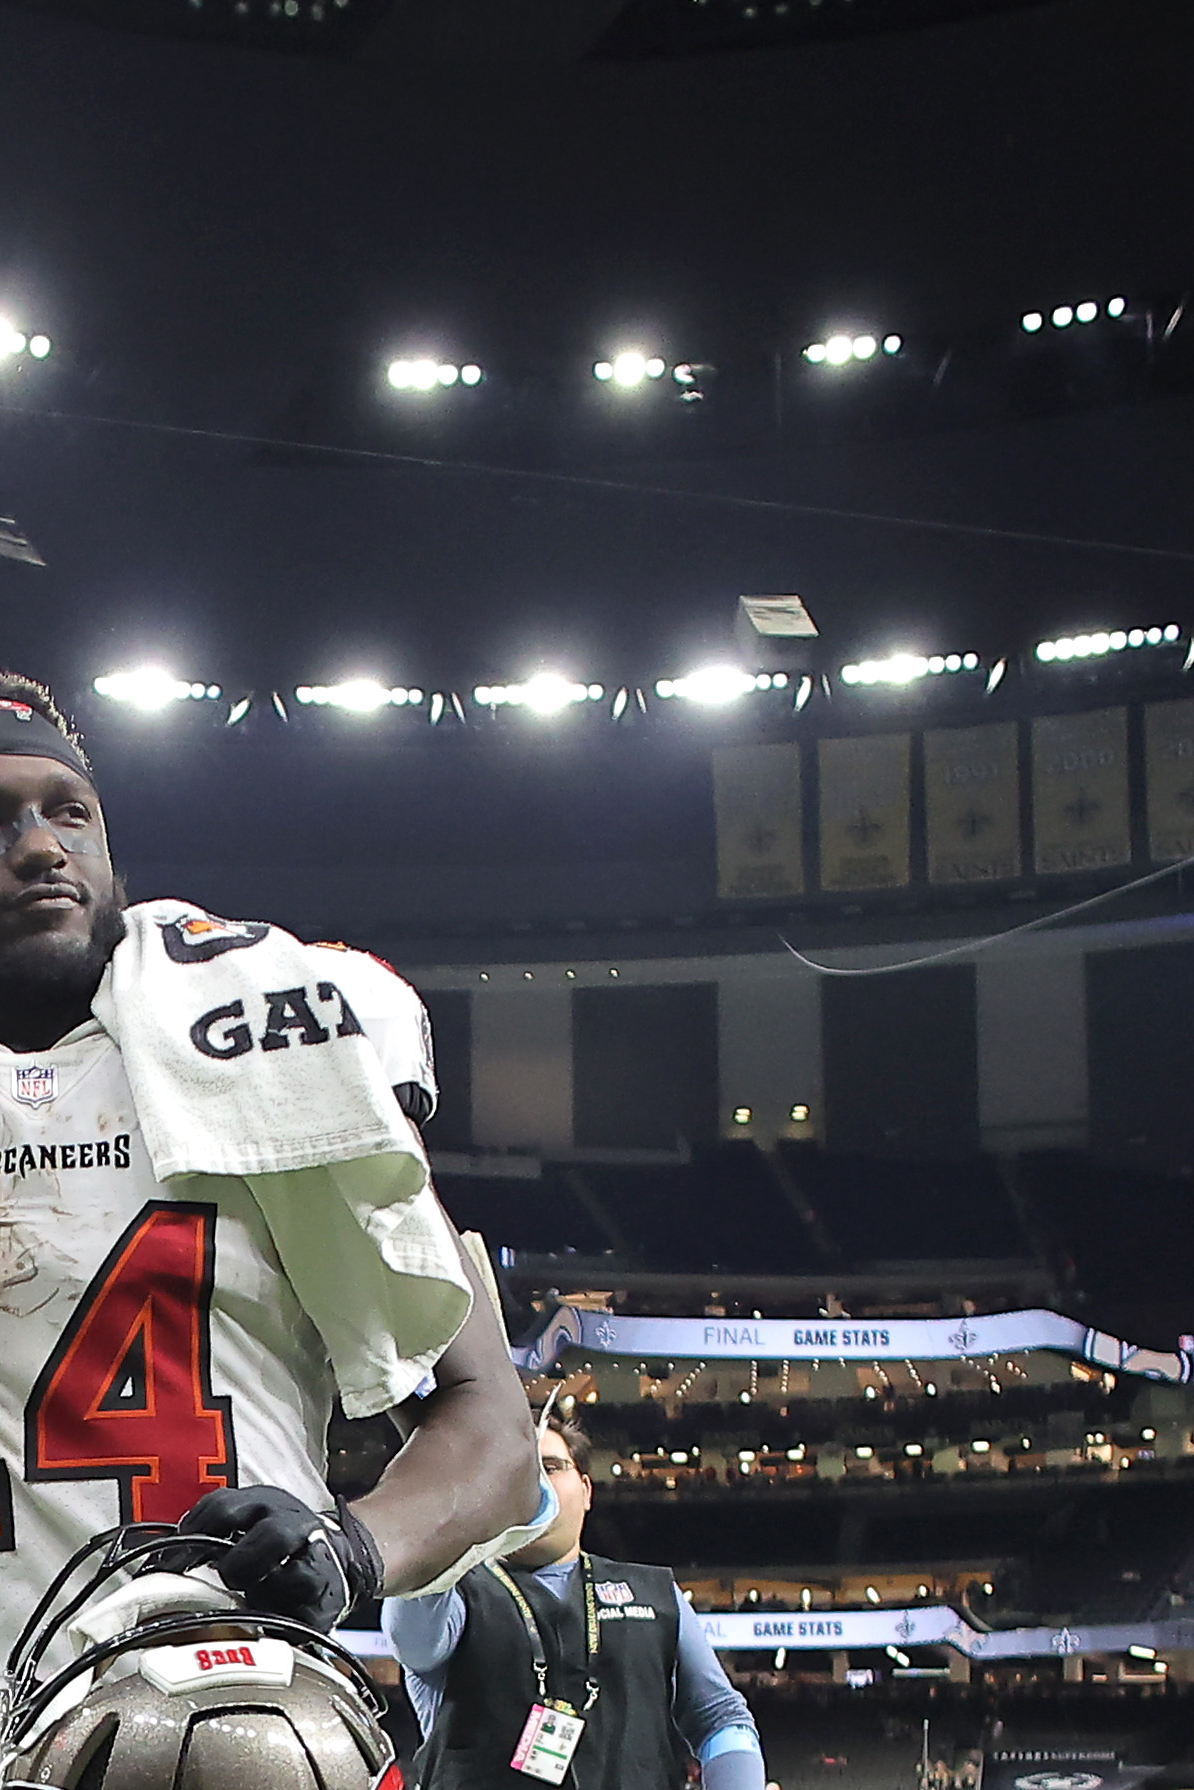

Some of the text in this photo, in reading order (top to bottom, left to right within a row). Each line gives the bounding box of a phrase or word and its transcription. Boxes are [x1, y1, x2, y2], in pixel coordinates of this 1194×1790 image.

[20, 1079, 51, 1099] NFL
[703, 1326, 890, 1346] FINAL GAME STATS
[624, 1605, 657, 1620] MEDIA
[753, 1621, 794, 1637] GAME
[798, 1621, 843, 1637] STATS
